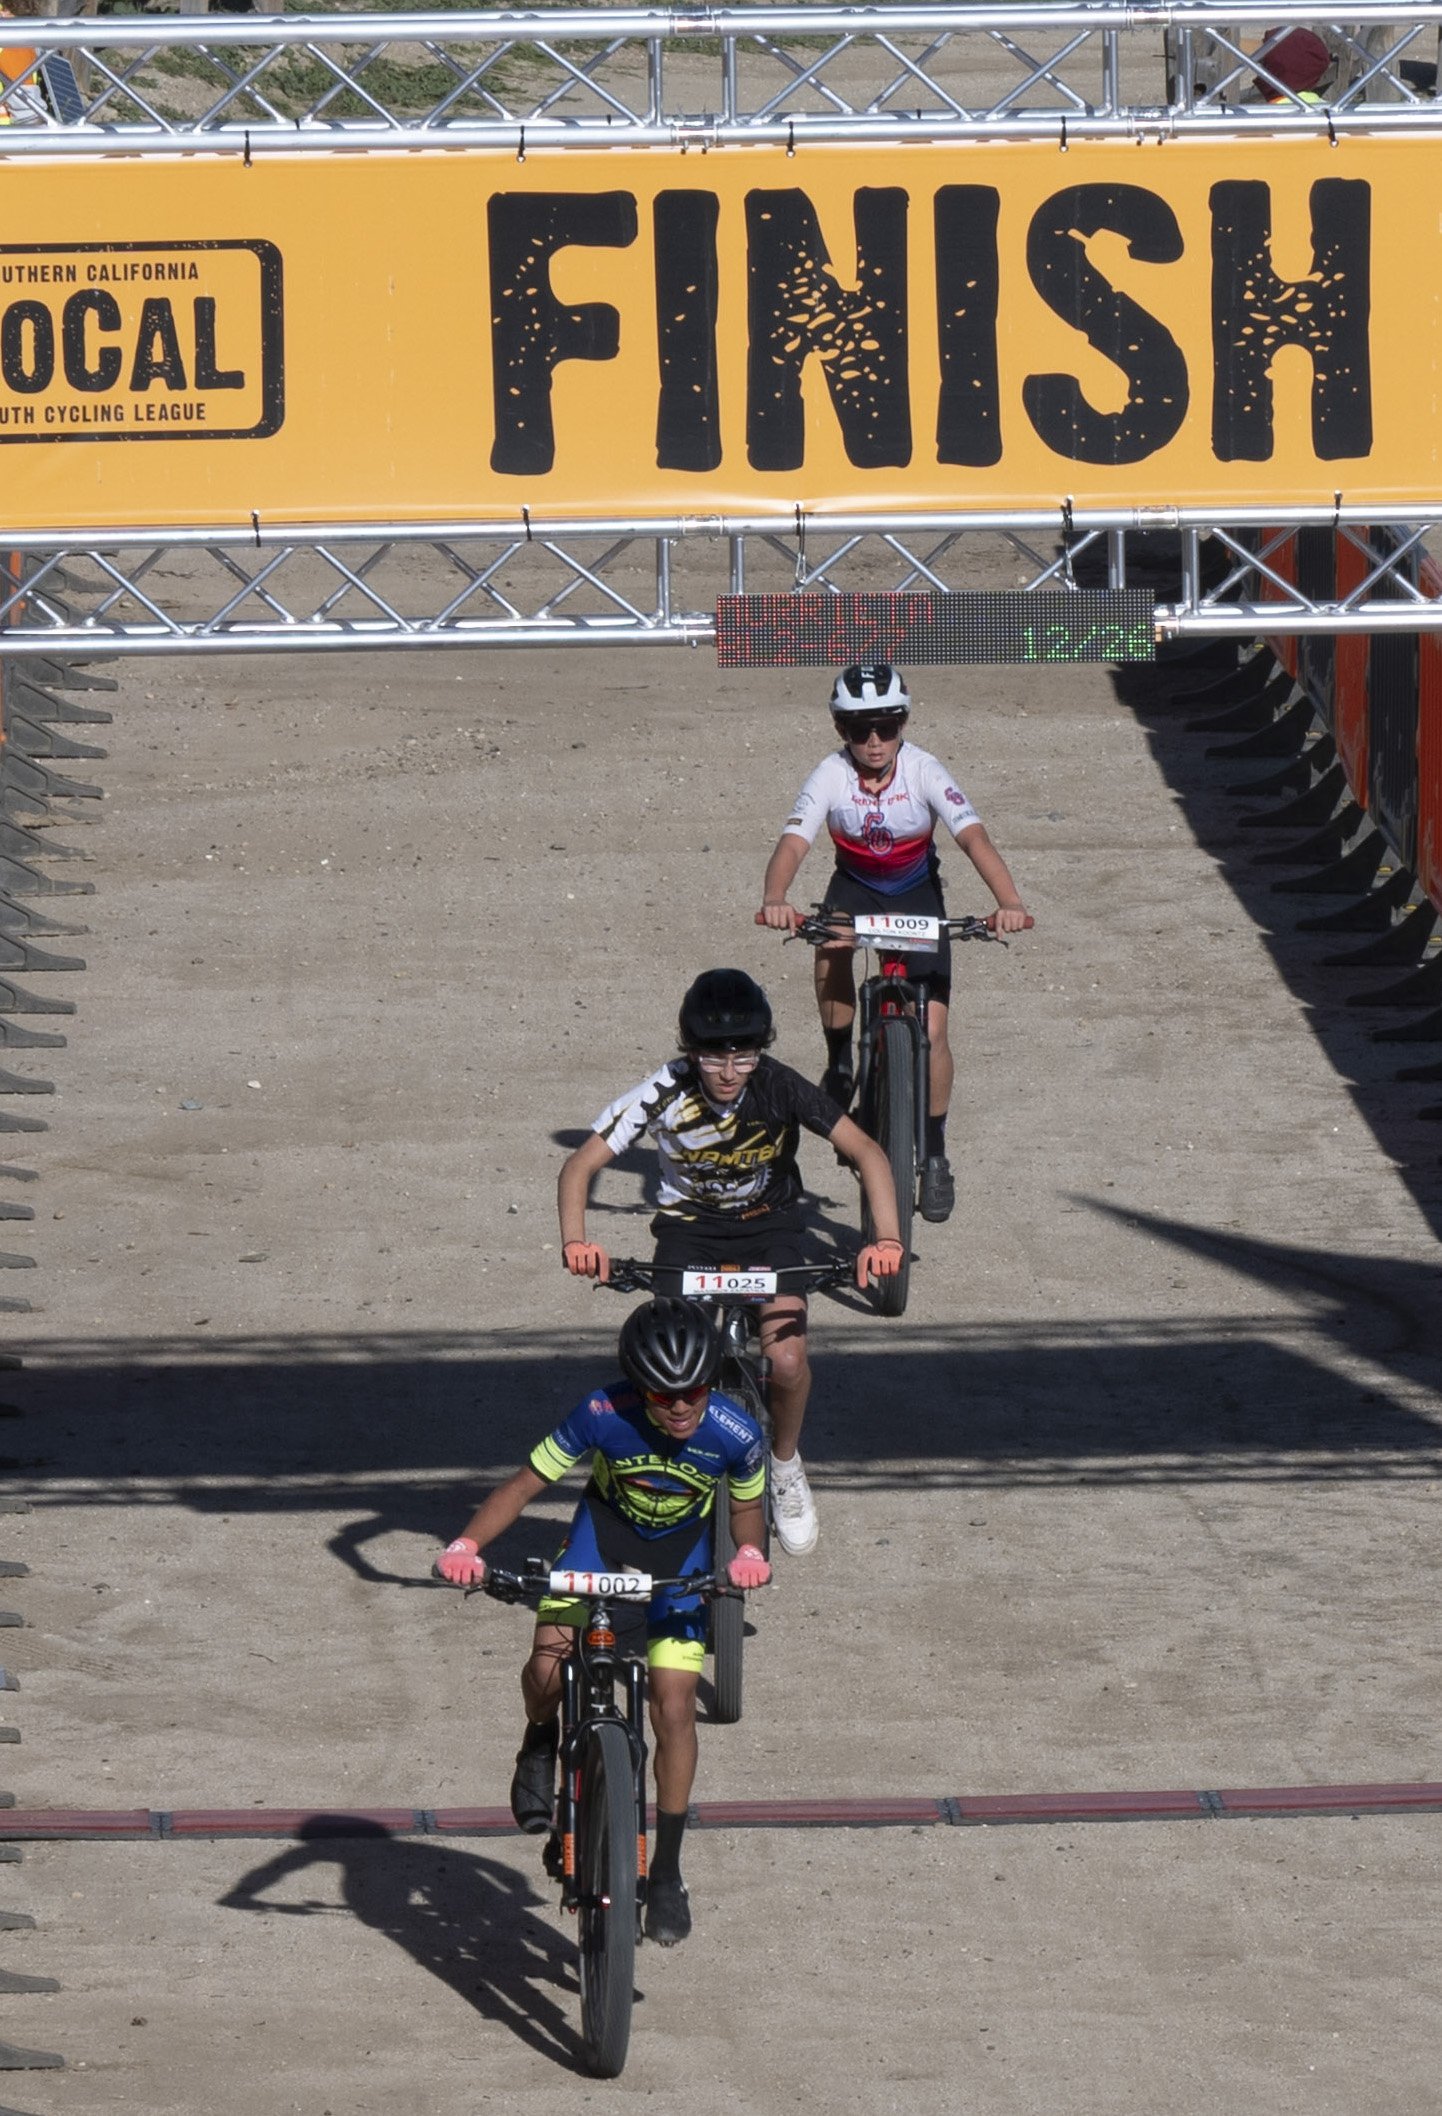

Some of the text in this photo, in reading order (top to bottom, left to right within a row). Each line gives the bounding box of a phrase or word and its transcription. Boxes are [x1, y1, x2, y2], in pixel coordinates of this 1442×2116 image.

[87, 262, 199, 281] CALIFORNIA
[1, 288, 245, 394] OCAL
[486, 177, 1372, 475] FINISH
[45, 404, 124, 422] CYCLING
[134, 403, 206, 421] LEAGUE
[1023, 624, 1152, 659] 12/26
[709, 1405, 754, 1444] ELEMENT
